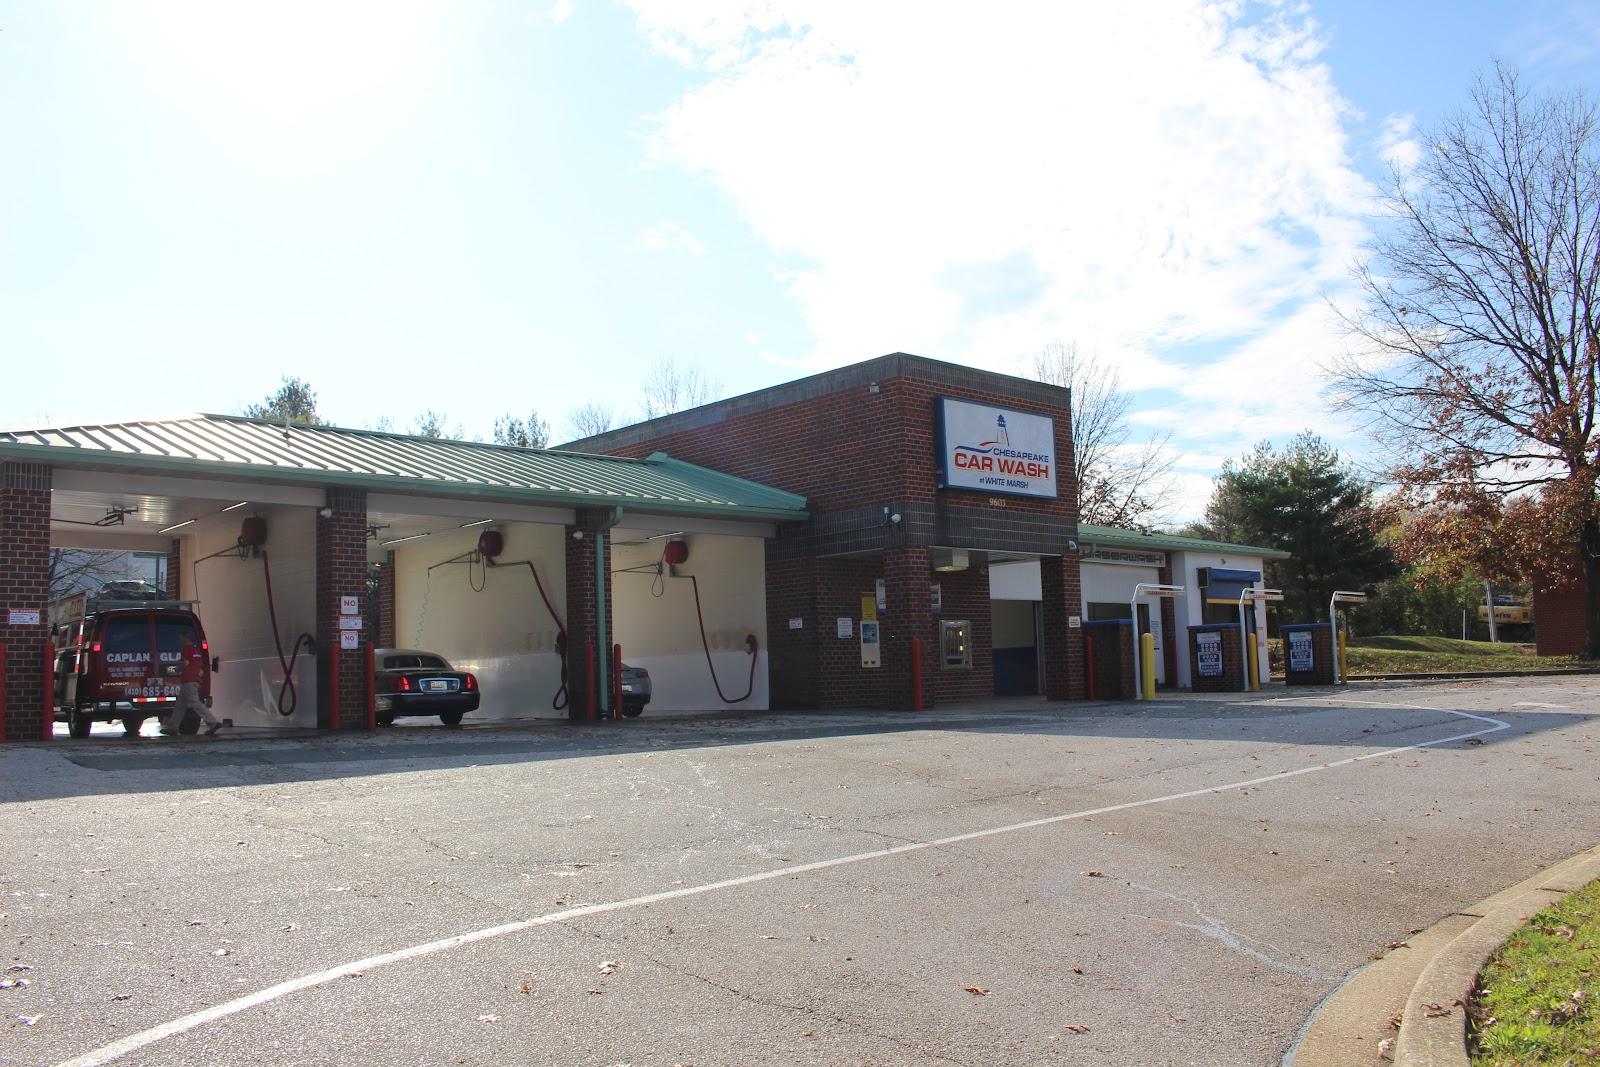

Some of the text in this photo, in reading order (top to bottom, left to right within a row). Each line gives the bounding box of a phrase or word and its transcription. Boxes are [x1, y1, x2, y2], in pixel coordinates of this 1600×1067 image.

[993, 448, 1049, 462] CHESAPEAKE
[954, 452, 1049, 478] CAR WASH
[985, 478, 1005, 486] WHITE
[1006, 480, 1029, 489] MARSH
[1088, 550, 1162, 563] ASERWASH
[106, 652, 181, 662] CAPLAN GLA
[143, 686, 180, 697] 685-640
